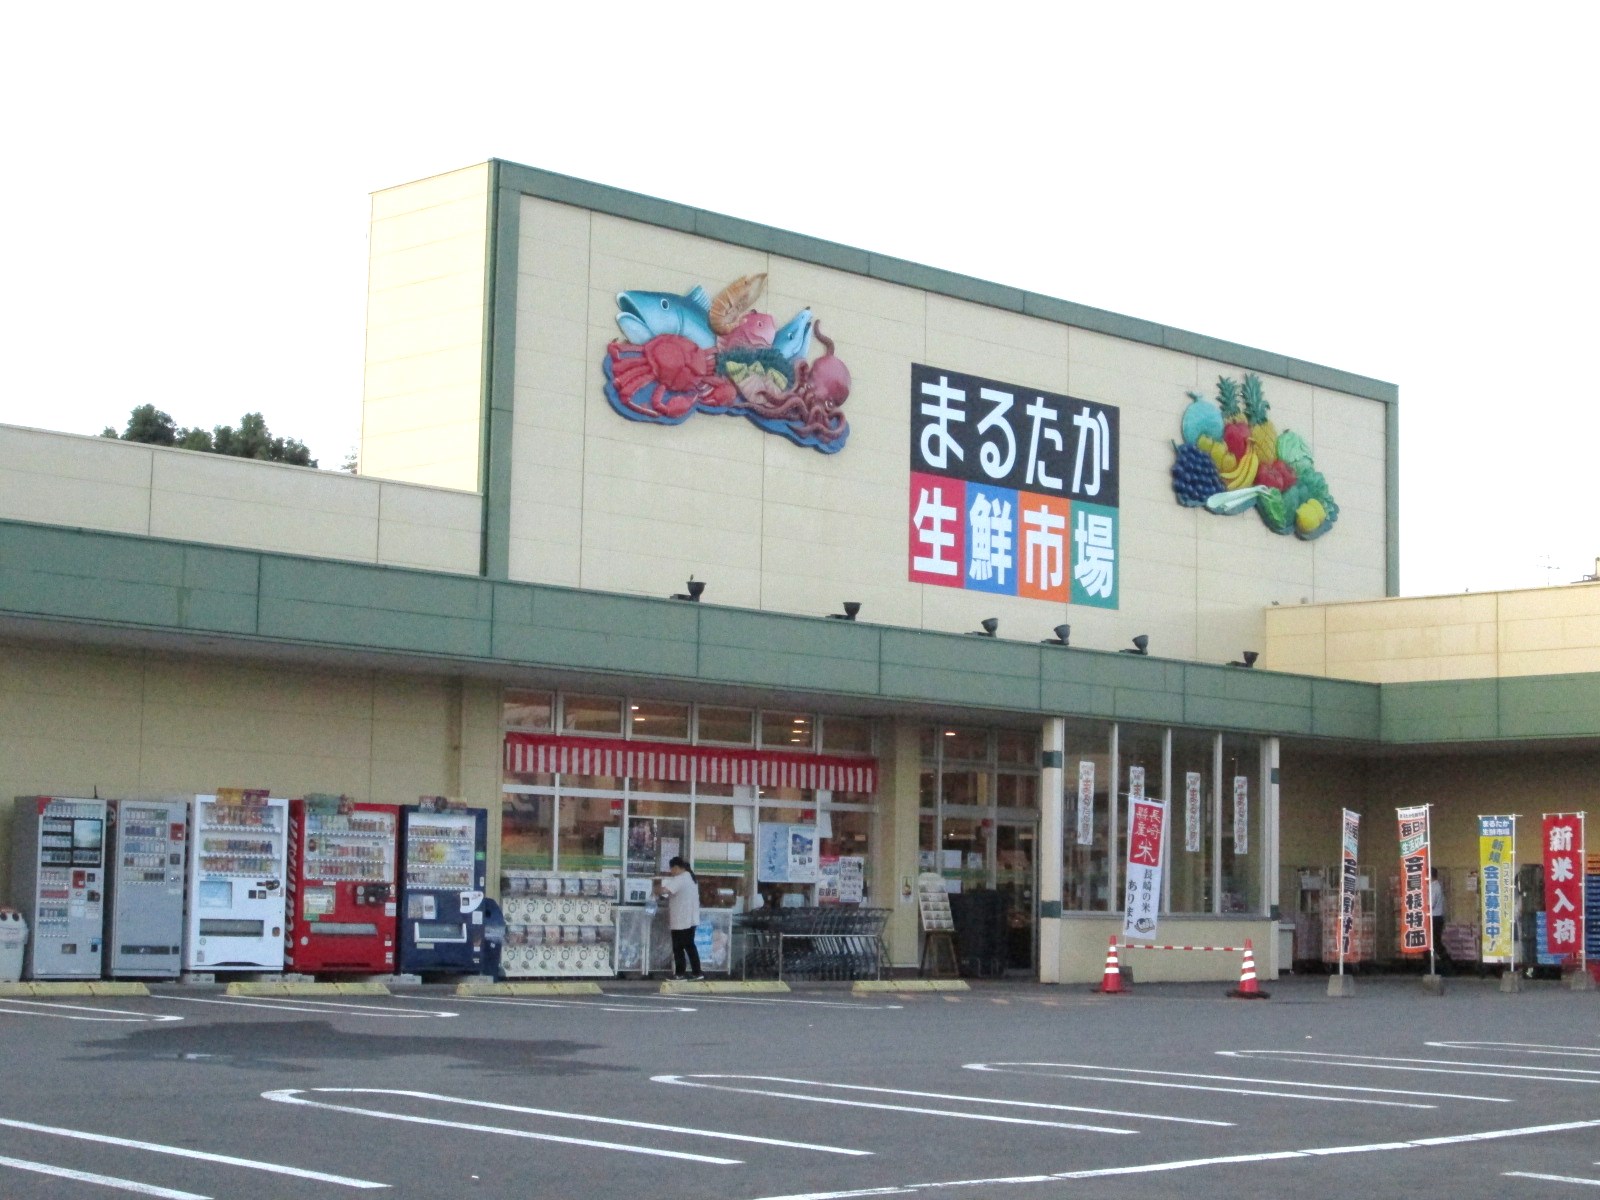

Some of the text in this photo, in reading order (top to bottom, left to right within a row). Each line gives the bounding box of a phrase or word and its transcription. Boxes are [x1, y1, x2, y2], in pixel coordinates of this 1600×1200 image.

[920, 375, 1110, 496] まるたか
[913, 487, 1115, 599] 生鮮市場
[1482, 820, 1510, 828] まるたか
[1482, 828, 1510, 836] 生鮮市場
[1134, 838, 1156, 863] 米
[1126, 879, 1138, 931] あります
[1142, 868, 1153, 914] 長崎の米
[1405, 855, 1427, 947] 会員様特価
[1549, 825, 1576, 945] 新米入荷
